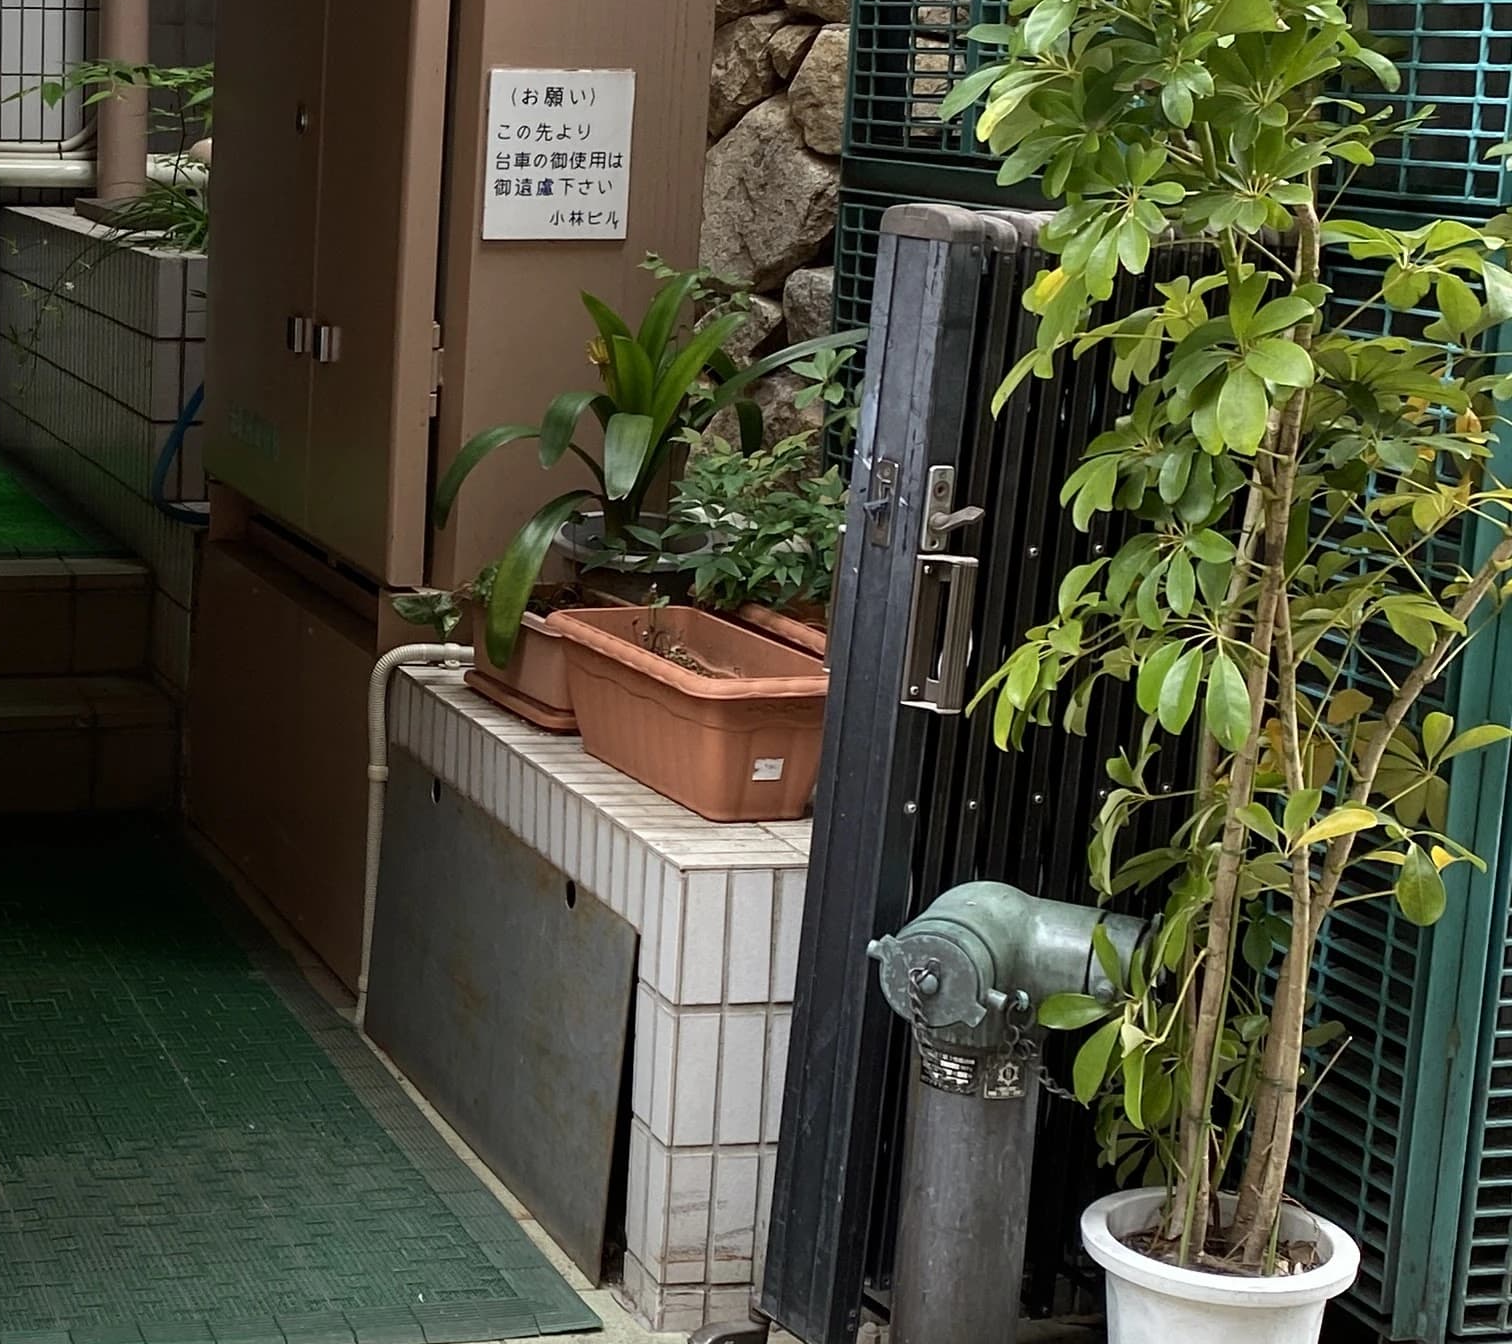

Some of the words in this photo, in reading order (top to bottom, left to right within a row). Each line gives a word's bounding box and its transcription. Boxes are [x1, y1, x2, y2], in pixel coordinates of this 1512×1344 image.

[497, 122, 591, 143] この先より
[495, 151, 624, 171] 台車の御使用は
[494, 177, 613, 197] 御遠慮下さい
[549, 209, 620, 230] 小林ビル
